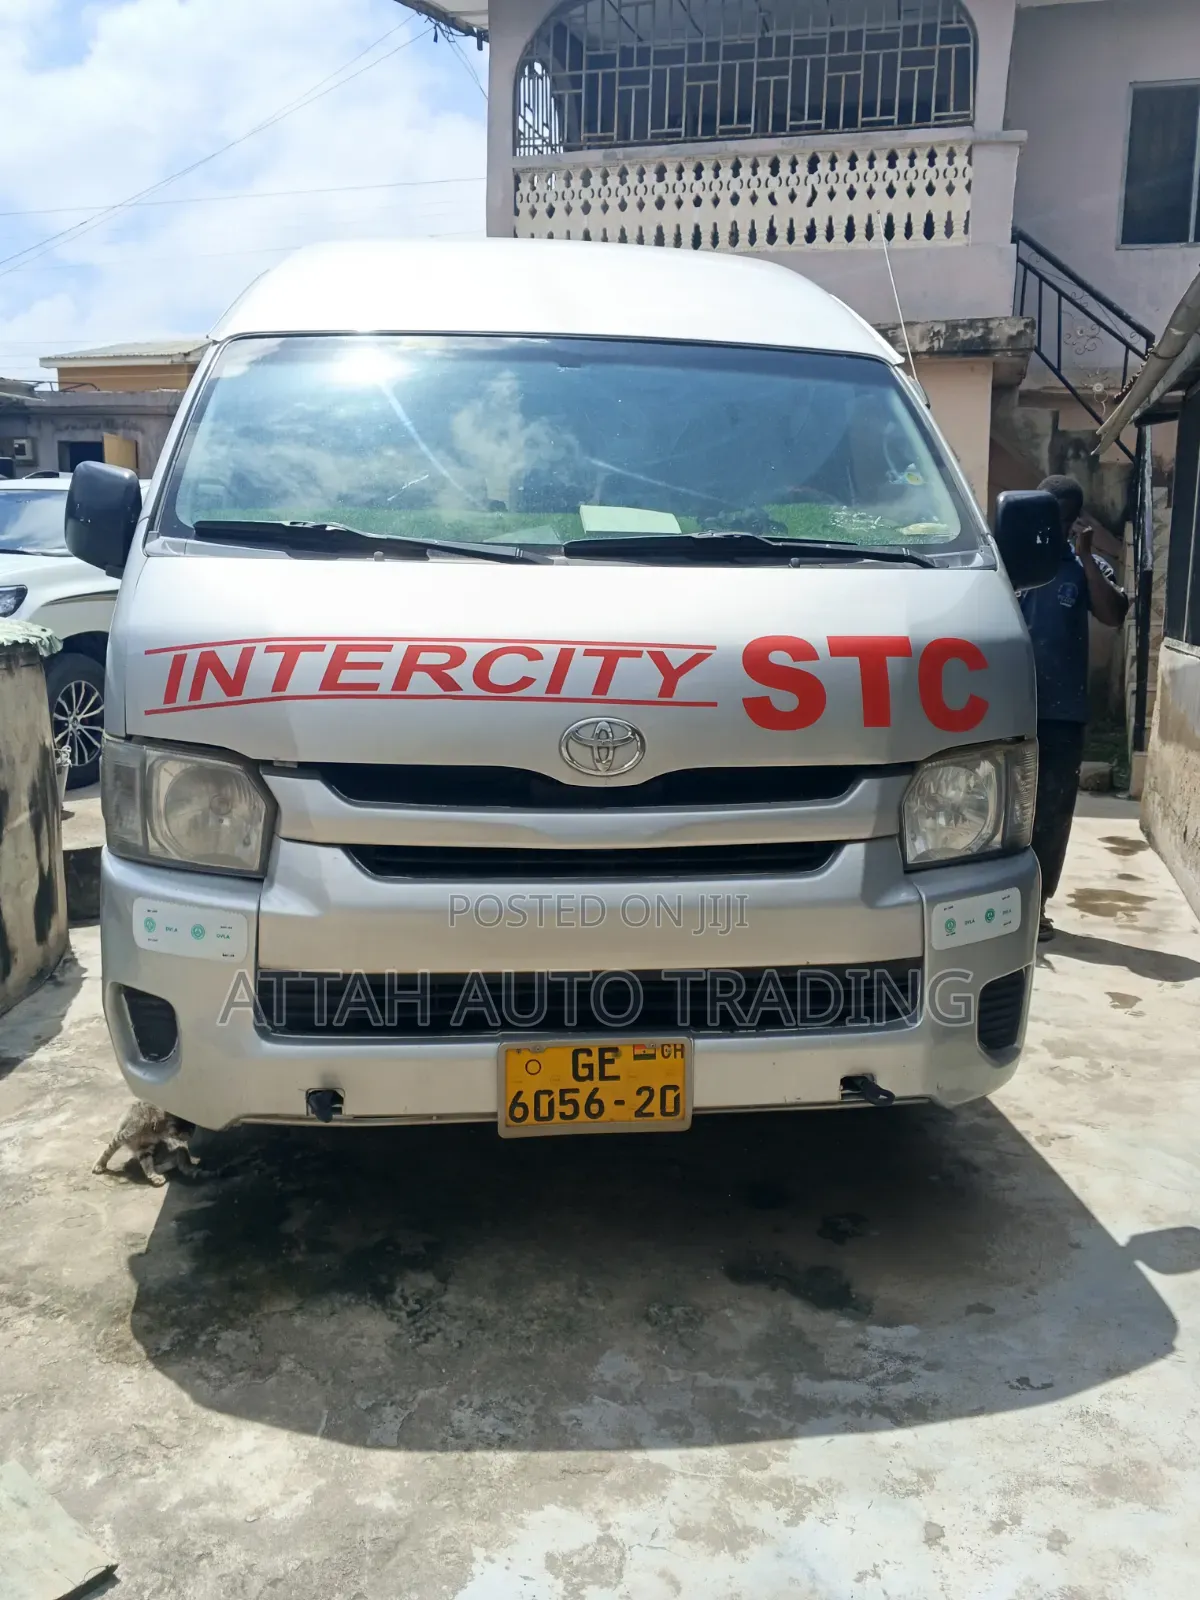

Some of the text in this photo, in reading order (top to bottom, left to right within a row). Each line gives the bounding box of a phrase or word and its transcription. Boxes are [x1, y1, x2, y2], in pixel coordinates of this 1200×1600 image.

[162, 635, 989, 732] INTERCITY STC
[572, 1047, 620, 1082] GE
[661, 1043, 685, 1060] GH
